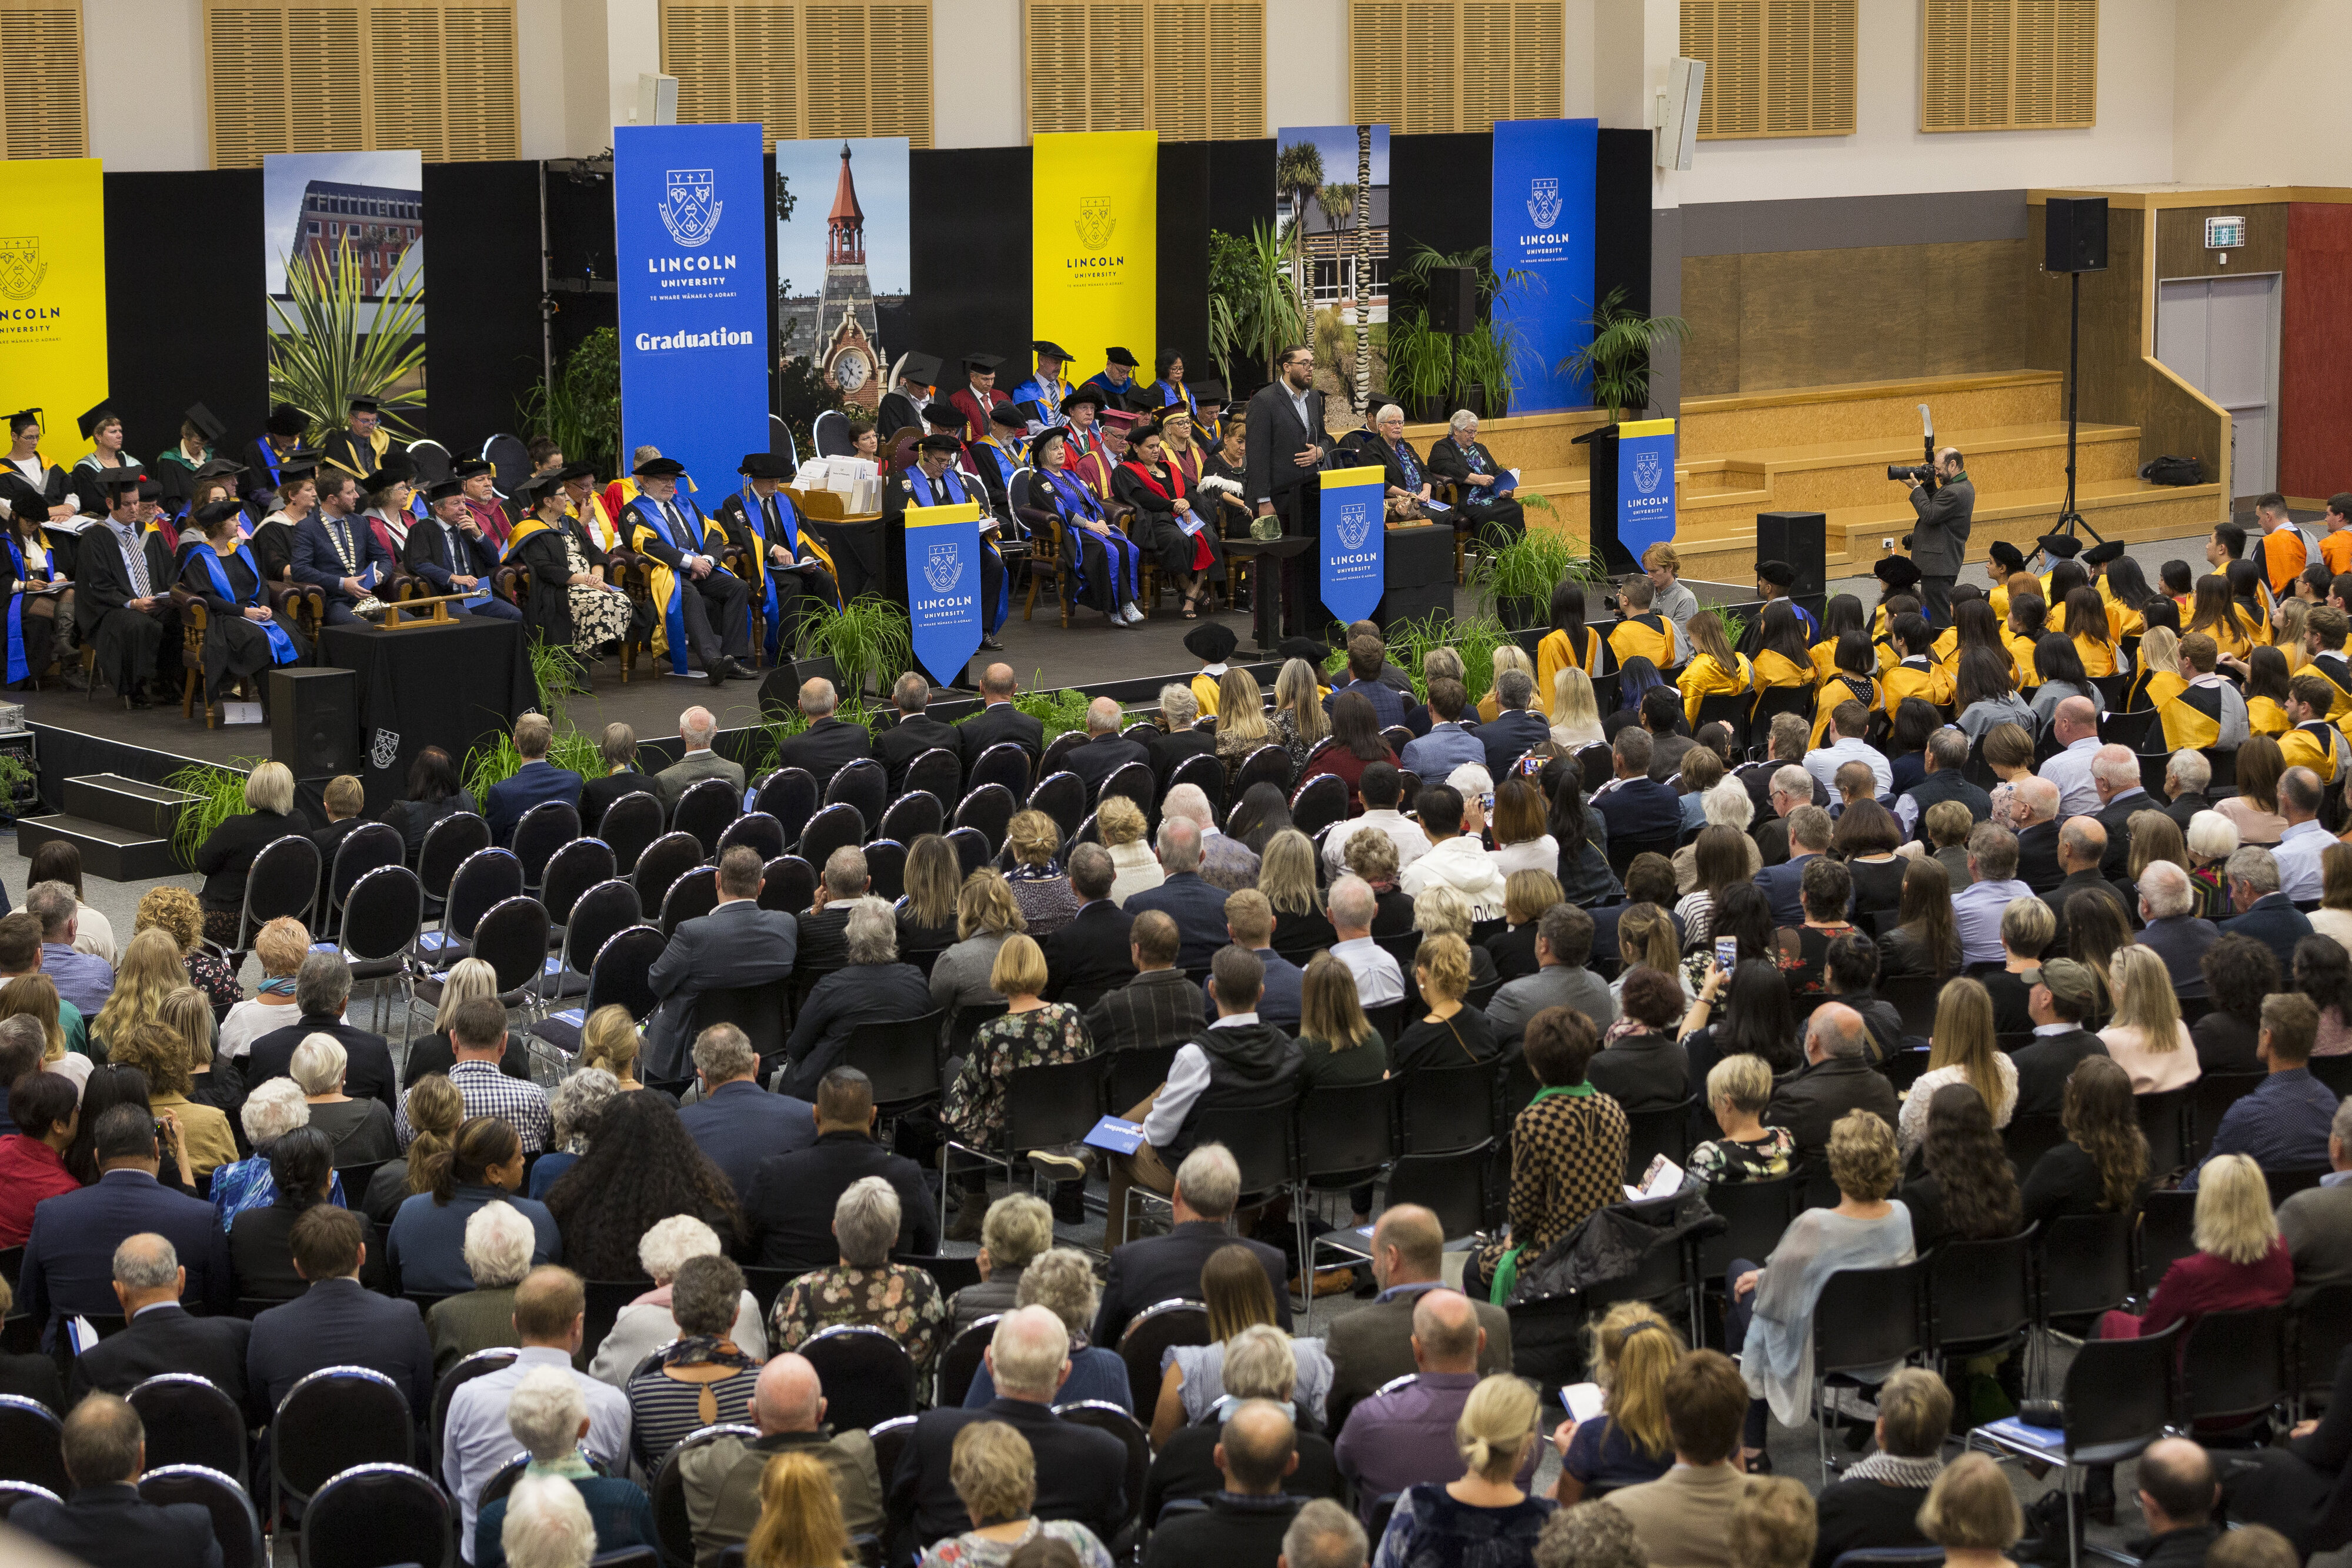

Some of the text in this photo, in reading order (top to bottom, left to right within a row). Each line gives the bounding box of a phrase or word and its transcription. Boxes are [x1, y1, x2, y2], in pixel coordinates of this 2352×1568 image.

[1520, 233, 1569, 245] LINCOLN
[649, 255, 736, 273] LINCOLN
[1067, 256, 1124, 268] LINCOLN
[661, 277, 725, 288] UNIVERSITY
[635, 326, 753, 351] Graduation
[1627, 496, 1669, 508] LINCOLN
[1331, 553, 1377, 565] LINCOLN
[918, 596, 972, 610] LINCOLN
[925, 610, 965, 619] UNIVERSITY
